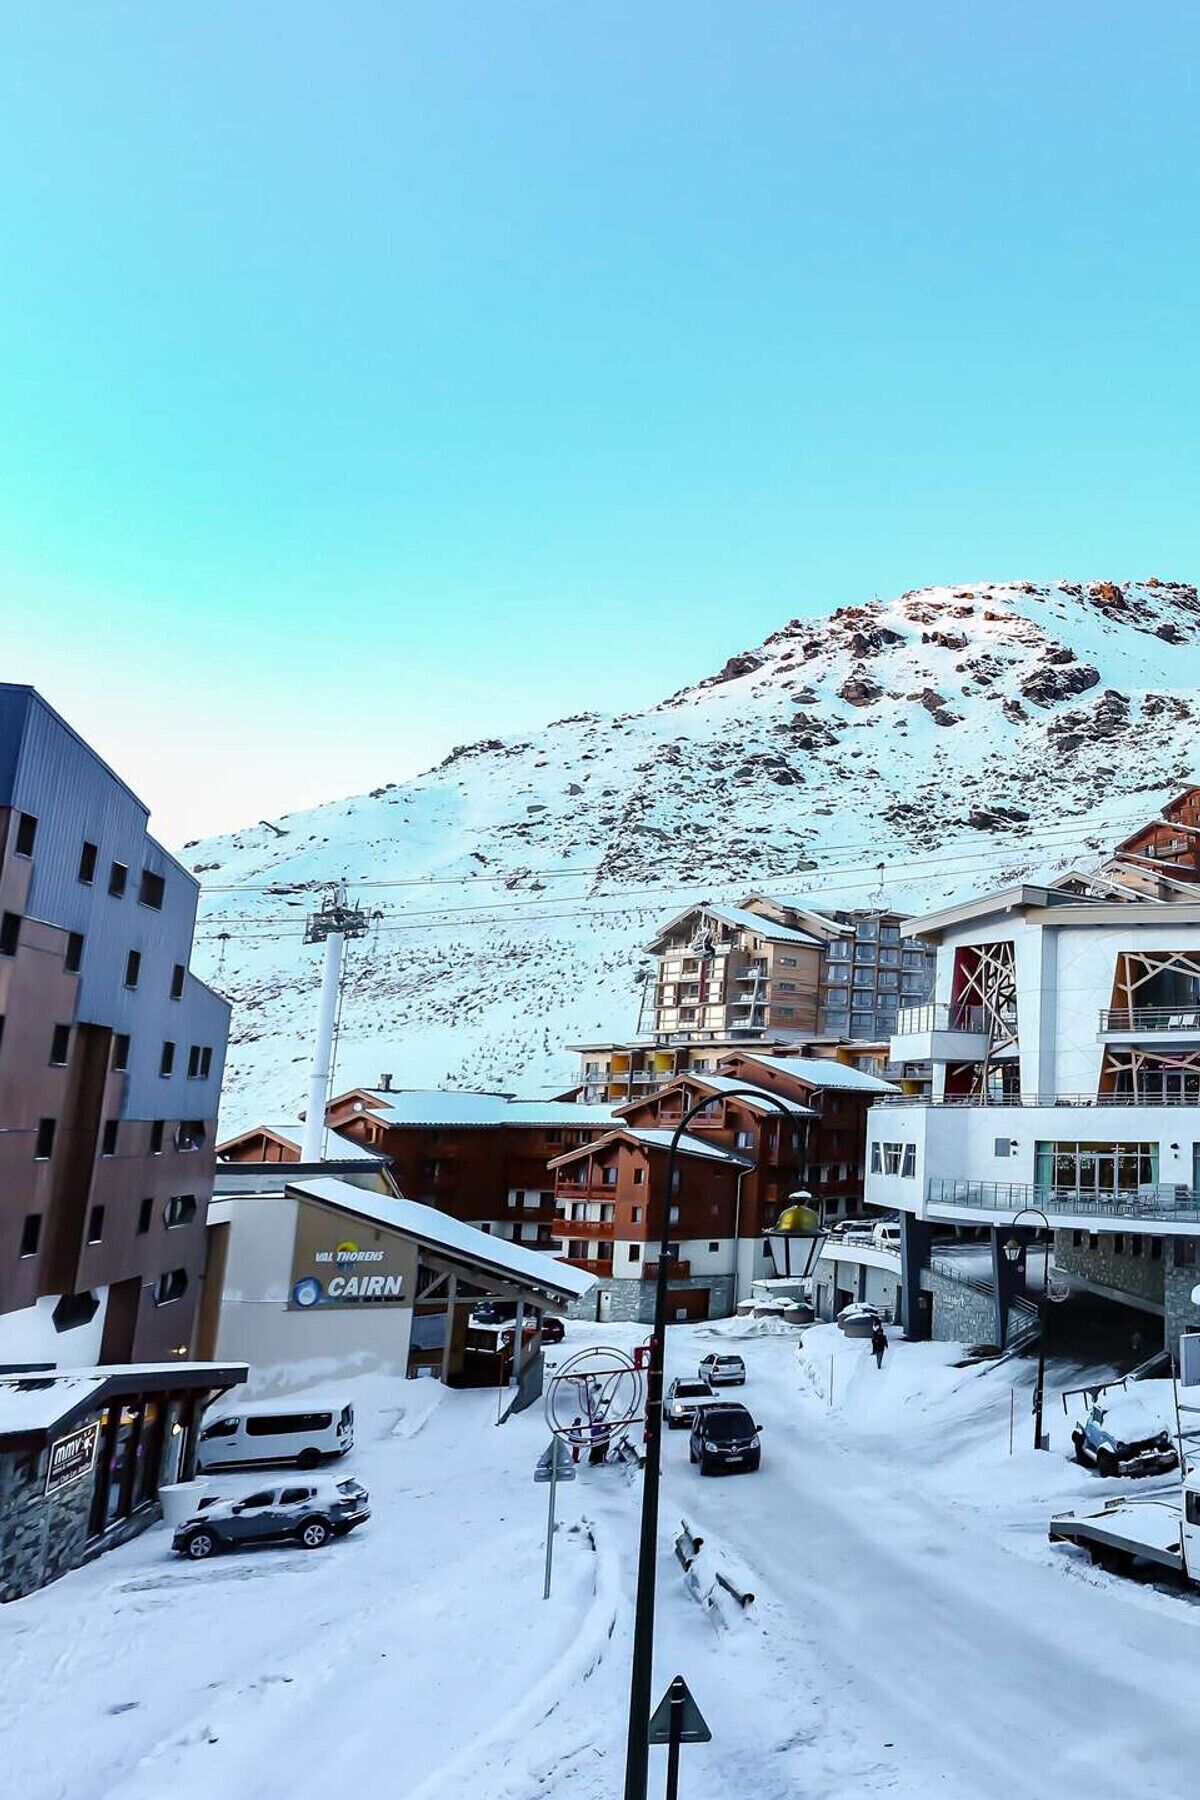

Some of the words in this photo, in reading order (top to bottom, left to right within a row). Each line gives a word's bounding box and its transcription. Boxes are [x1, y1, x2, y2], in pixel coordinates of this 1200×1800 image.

[315, 1251, 333, 1262] VAL
[336, 1251, 385, 1261] THORENS
[328, 1276, 403, 1298] CAIRN
